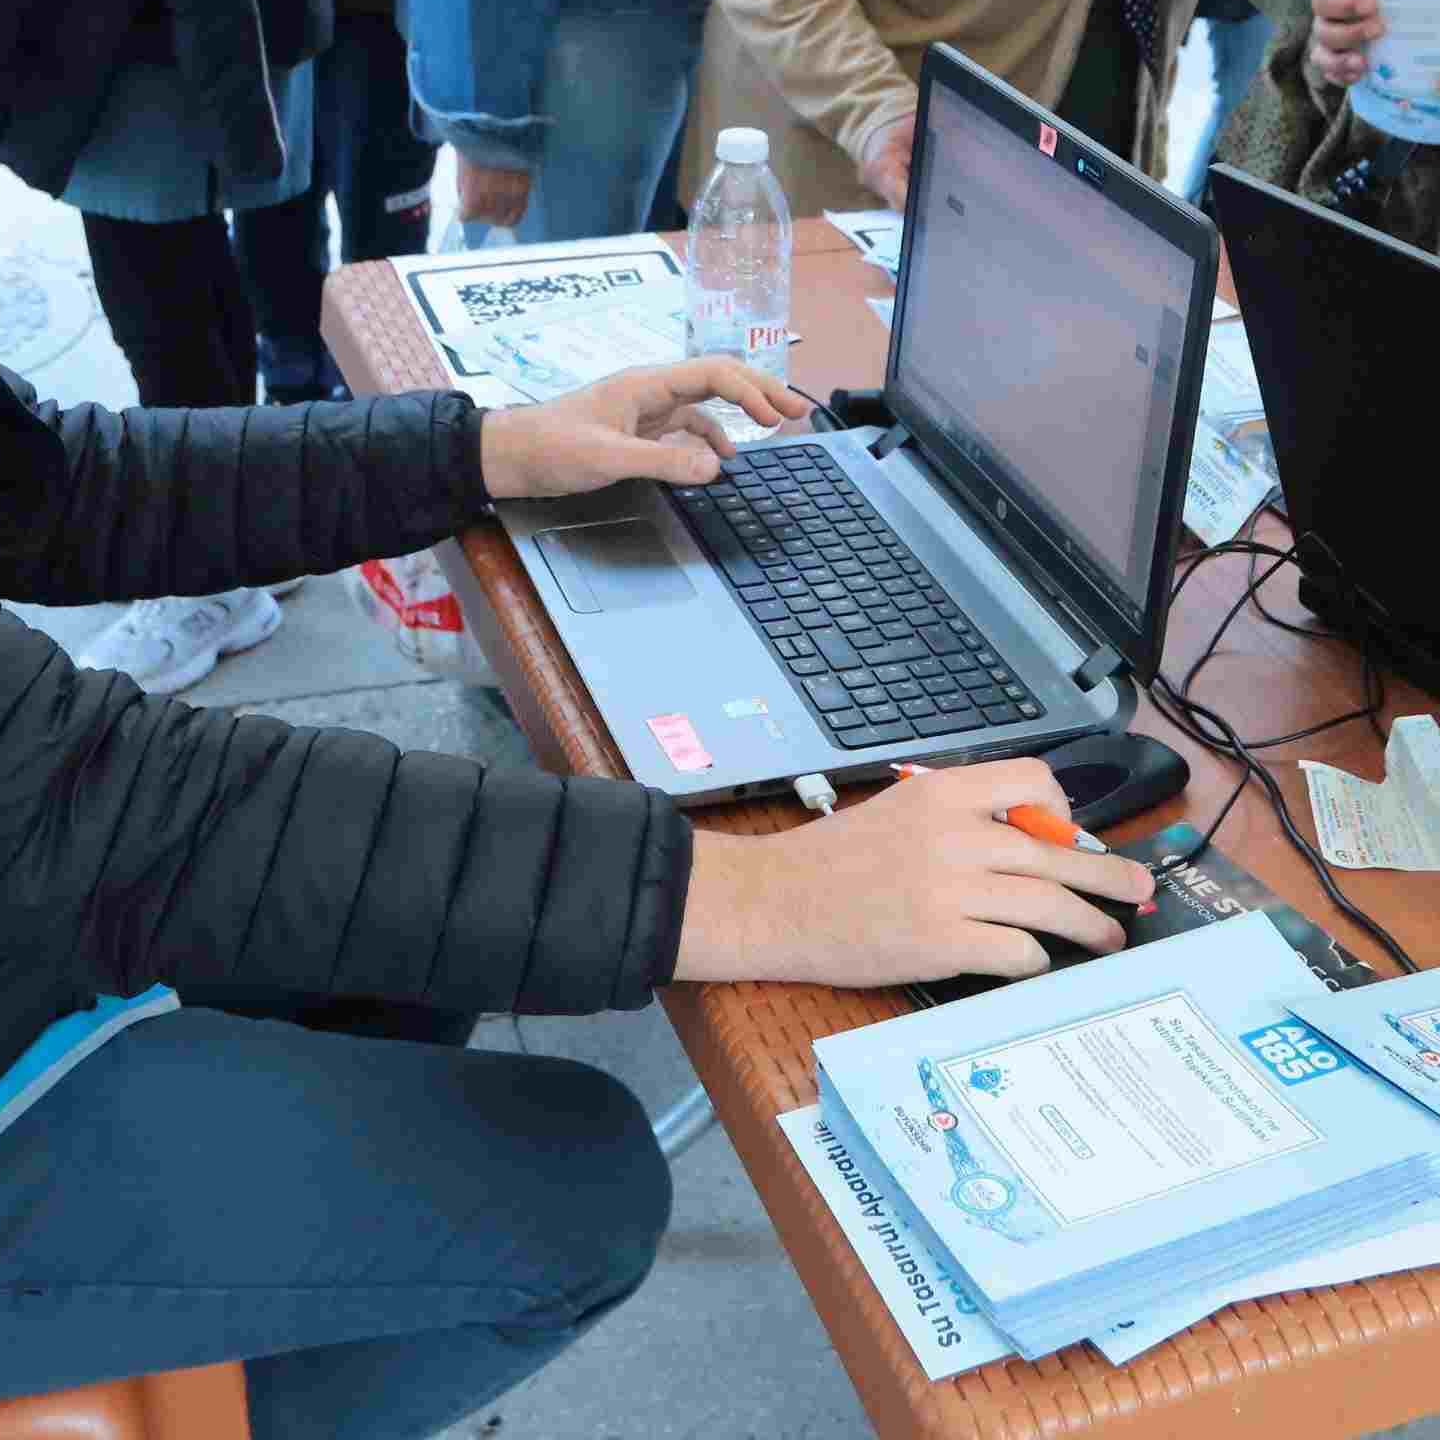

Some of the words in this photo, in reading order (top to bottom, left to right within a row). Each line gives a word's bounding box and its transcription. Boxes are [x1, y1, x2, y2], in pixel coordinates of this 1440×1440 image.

[1251, 1029, 1307, 1080] 185
[1276, 1026, 1338, 1070] ALO
[826, 1143, 886, 1218] Aparatı
[868, 1220, 942, 1317] Tasarruf
[932, 1315, 963, 1348] Su
